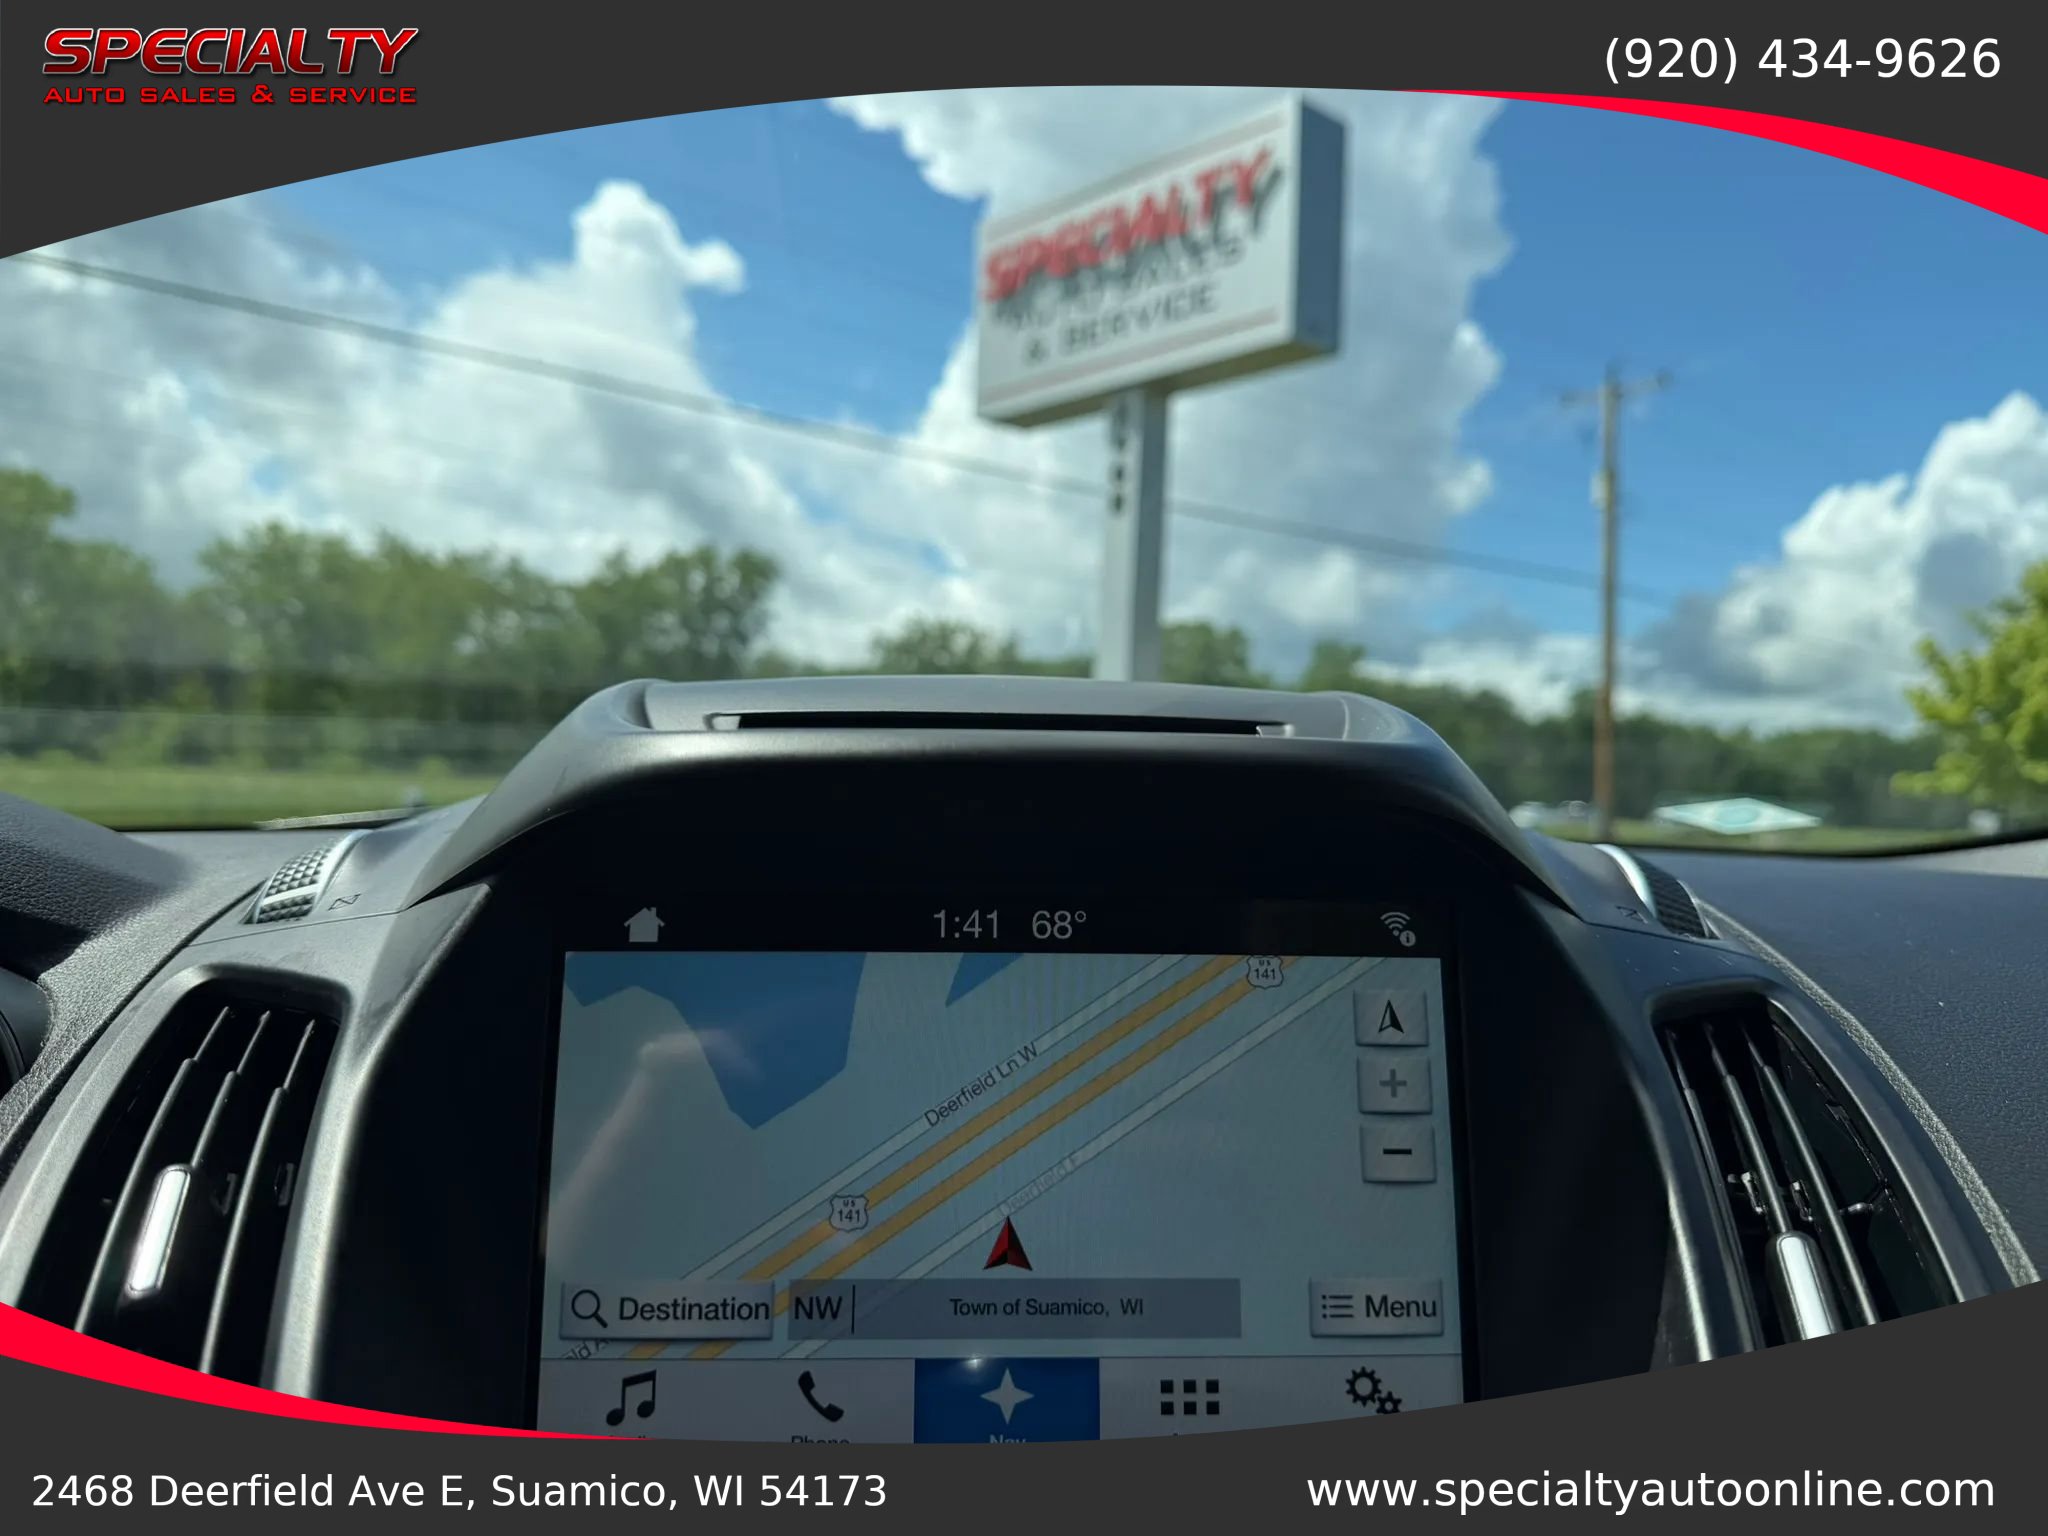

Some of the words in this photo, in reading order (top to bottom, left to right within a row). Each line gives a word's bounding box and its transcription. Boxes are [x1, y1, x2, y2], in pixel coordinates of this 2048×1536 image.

[983, 147, 1278, 304] SPECIALTY
[933, 909, 999, 939] 1:41
[1032, 910, 1087, 940] 68°
[1254, 967, 1276, 980] 141
[924, 1070, 996, 1127] Deerfield
[996, 1061, 1020, 1079] Ln
[1018, 1041, 1039, 1062] W
[838, 1208, 860, 1222] 141
[842, 1199, 856, 1208] US
[619, 1296, 771, 1321] Destination
[794, 1295, 843, 1321] NW
[949, 1298, 998, 1316] Town
[1003, 1298, 1021, 1316] of
[1026, 1298, 1110, 1319] Suamico,
[1119, 1298, 1144, 1315] WI
[1365, 1294, 1438, 1318] Menu
